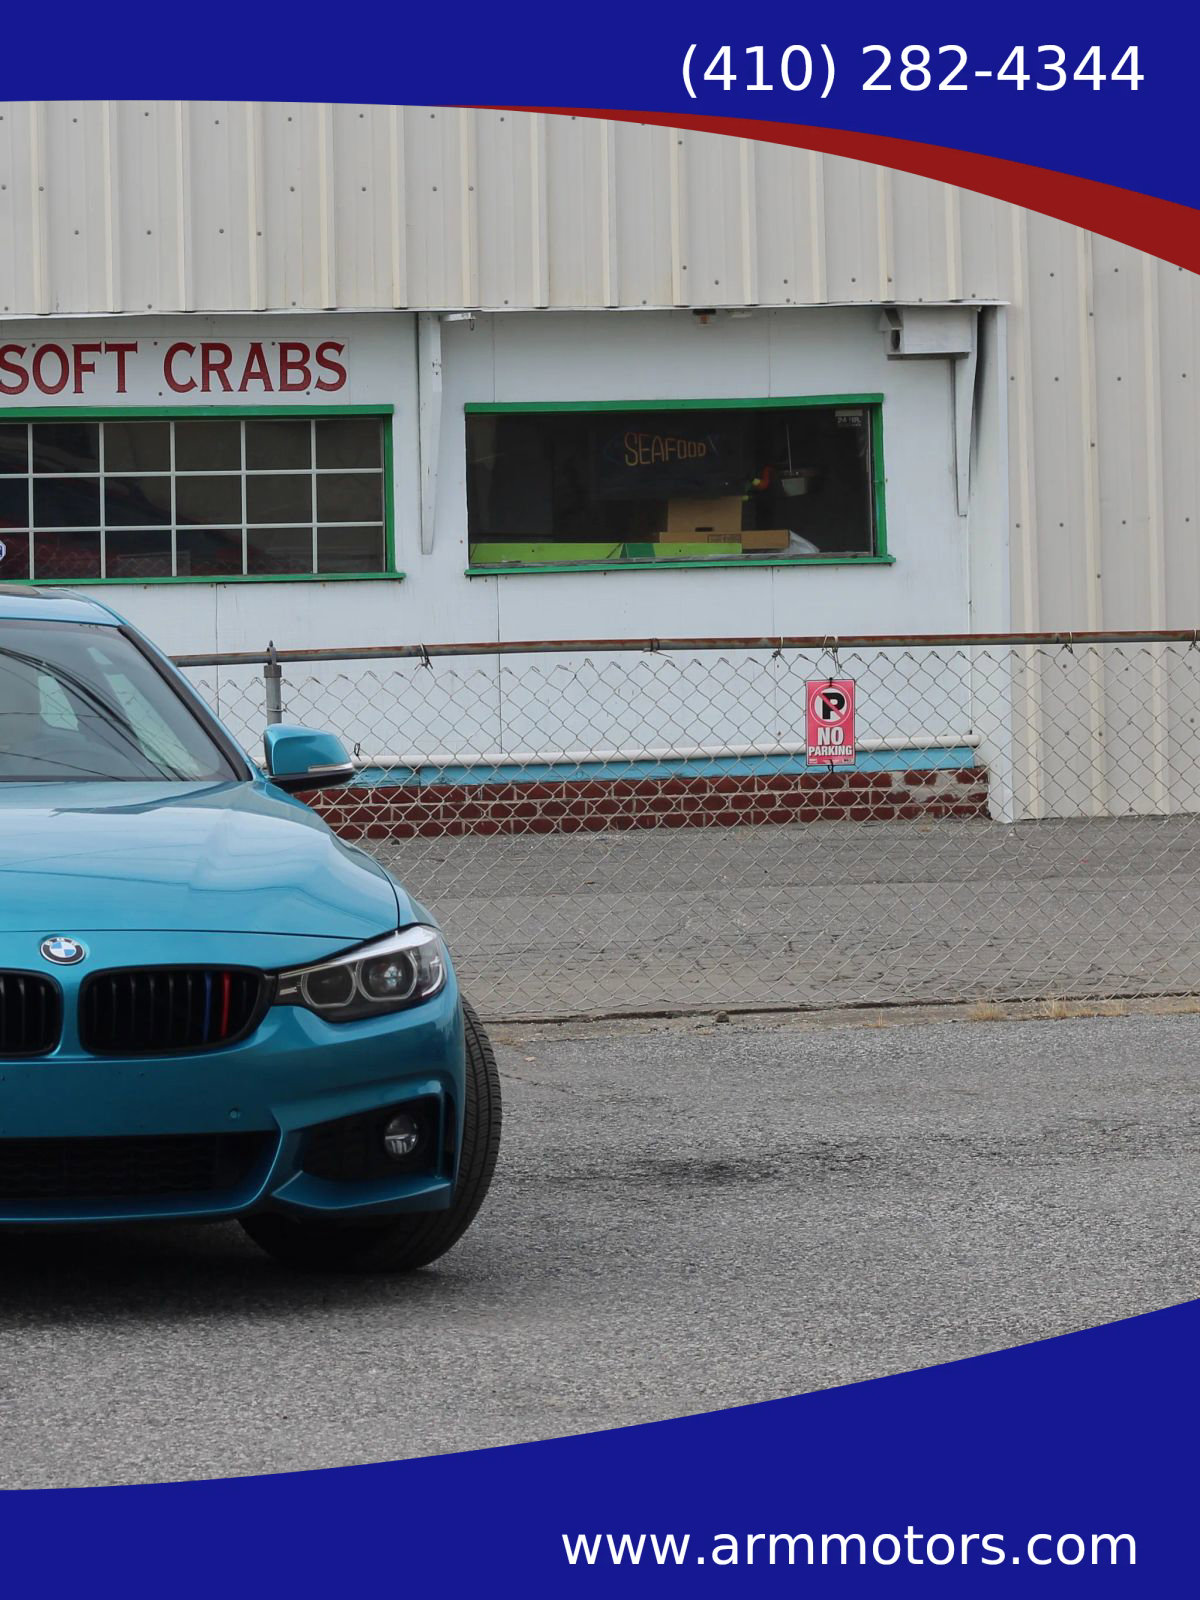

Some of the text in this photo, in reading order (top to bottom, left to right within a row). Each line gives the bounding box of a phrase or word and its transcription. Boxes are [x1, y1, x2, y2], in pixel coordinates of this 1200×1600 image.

[163, 341, 348, 394] CRABS
[623, 432, 708, 467] SEAFOOD
[817, 726, 844, 746] NO
[808, 745, 853, 757] PARKING
